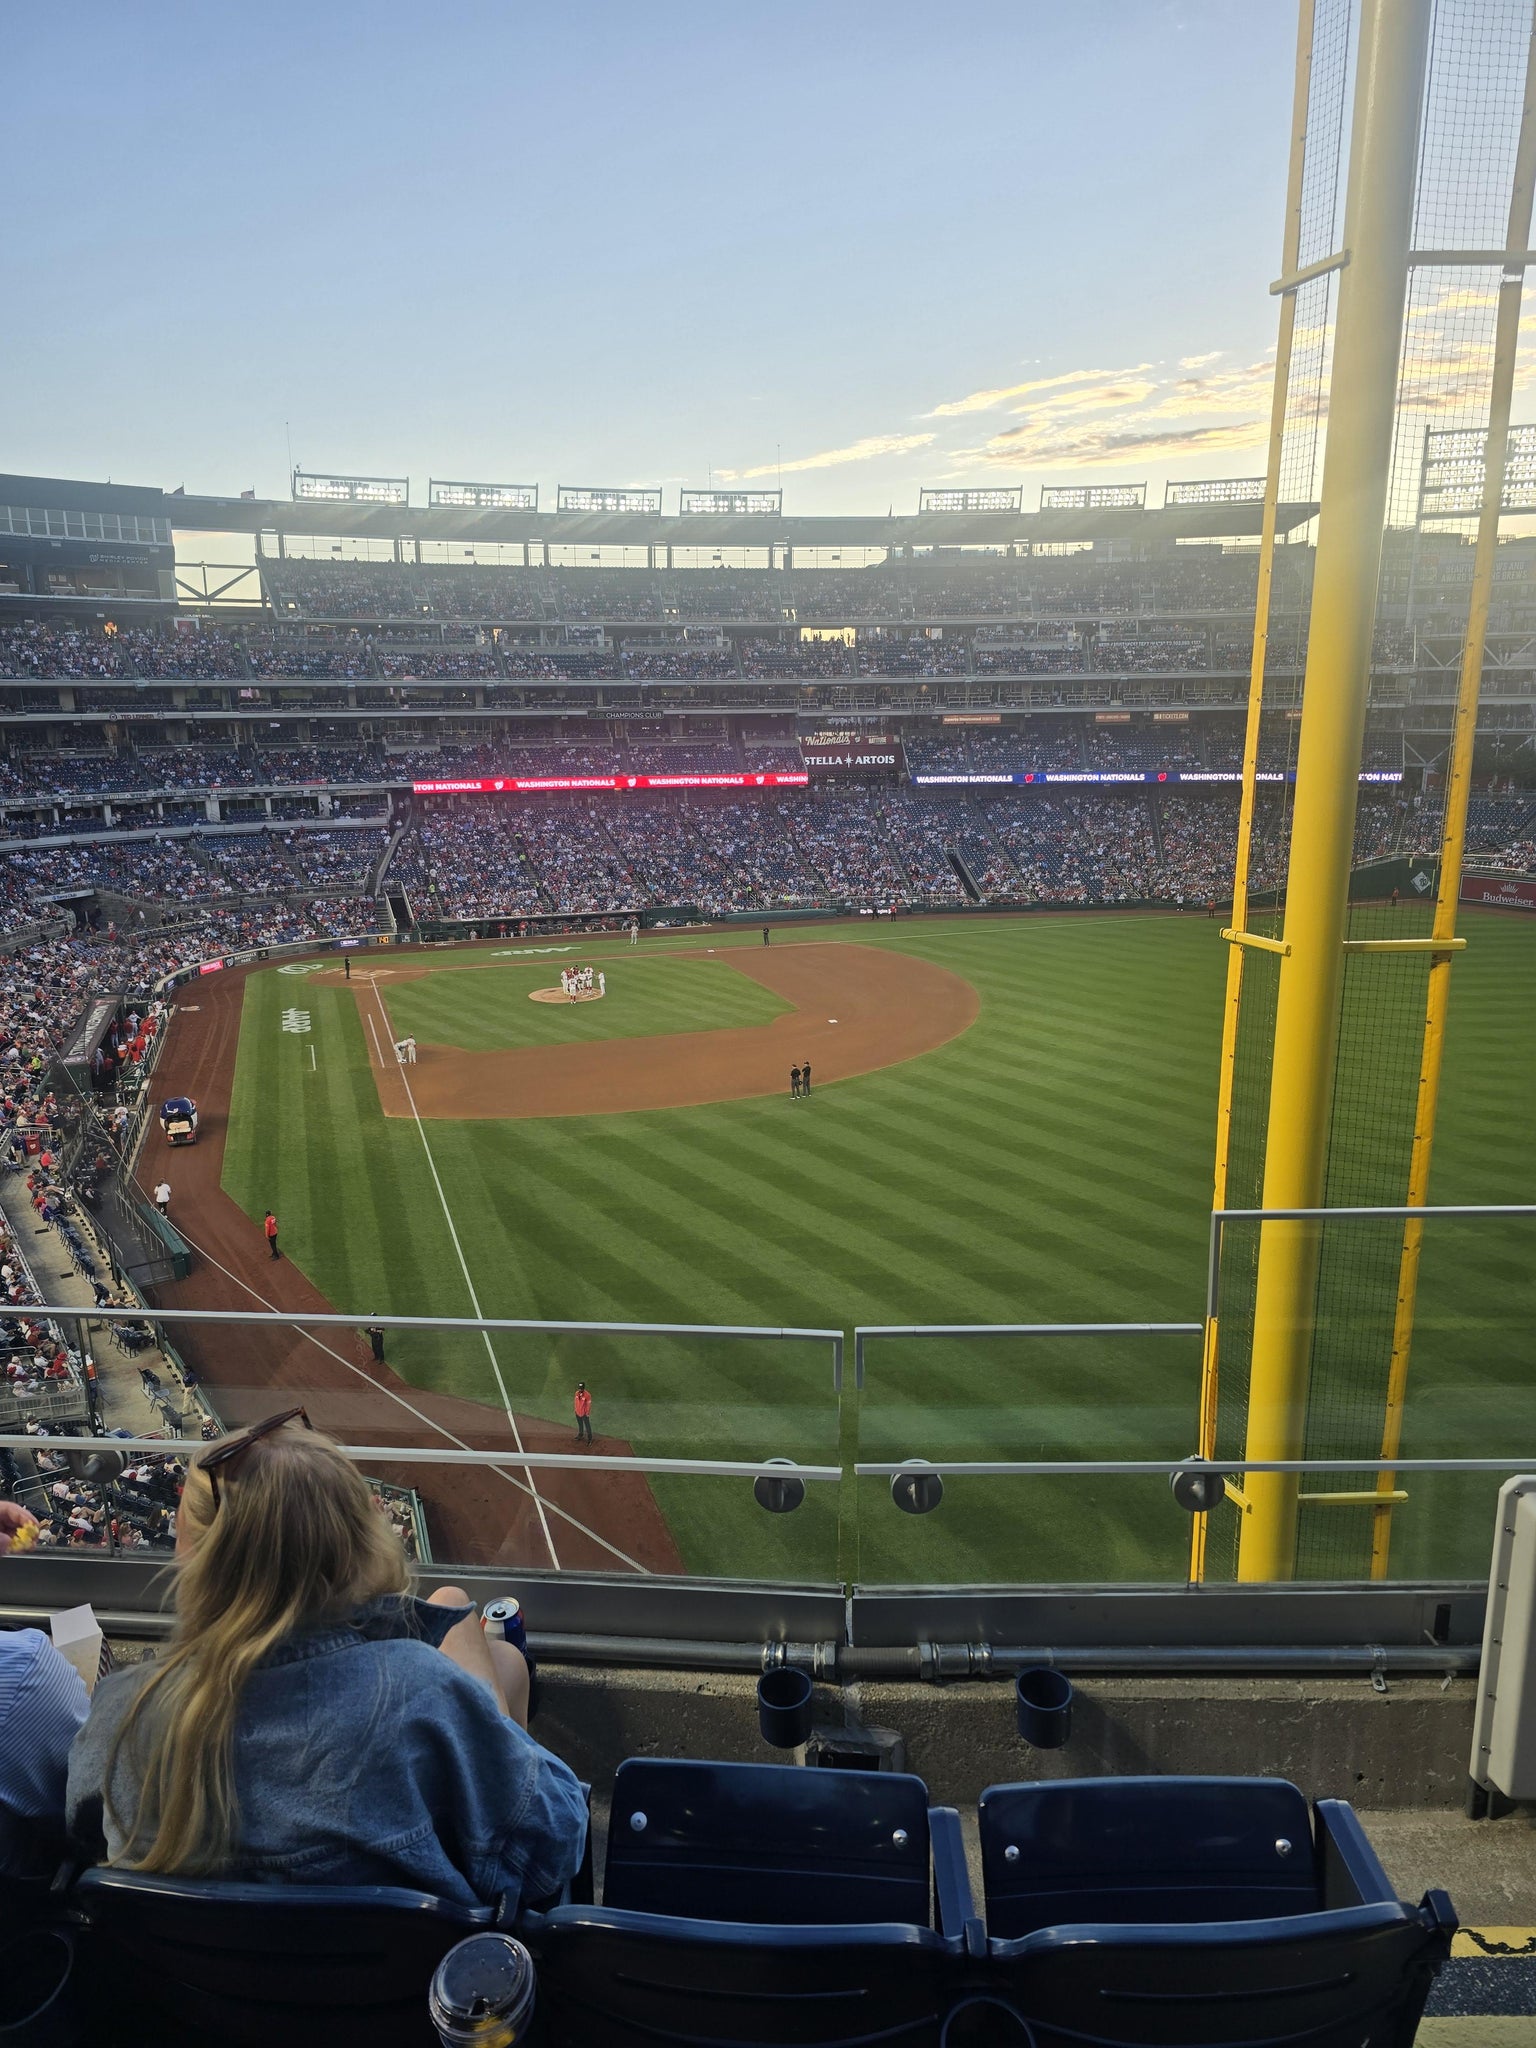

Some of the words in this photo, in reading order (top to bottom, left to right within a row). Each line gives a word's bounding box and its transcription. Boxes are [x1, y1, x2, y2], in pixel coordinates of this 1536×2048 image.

[645, 711, 662, 719] CLUB
[805, 735, 850, 746] Nationals
[804, 756, 843, 766] STELLA
[854, 755, 895, 765] ARTOIS
[648, 777, 700, 785] WASHINGTON
[701, 776, 744, 784] NATIONALS
[916, 775, 969, 784] WASHINGTON
[969, 774, 1013, 783] NATIONALS
[1045, 774, 1099, 782] WASHINGTON
[1100, 773, 1145, 781] NATIONALS
[1180, 773, 1235, 781] WASHINGTON
[435, 782, 482, 791] NATIONALS
[516, 780, 570, 788] WASHINGTON
[571, 779, 616, 787] NATIONALS
[1482, 891, 1535, 906] Budweiser
[234, 952, 257, 961] NATIONALS
